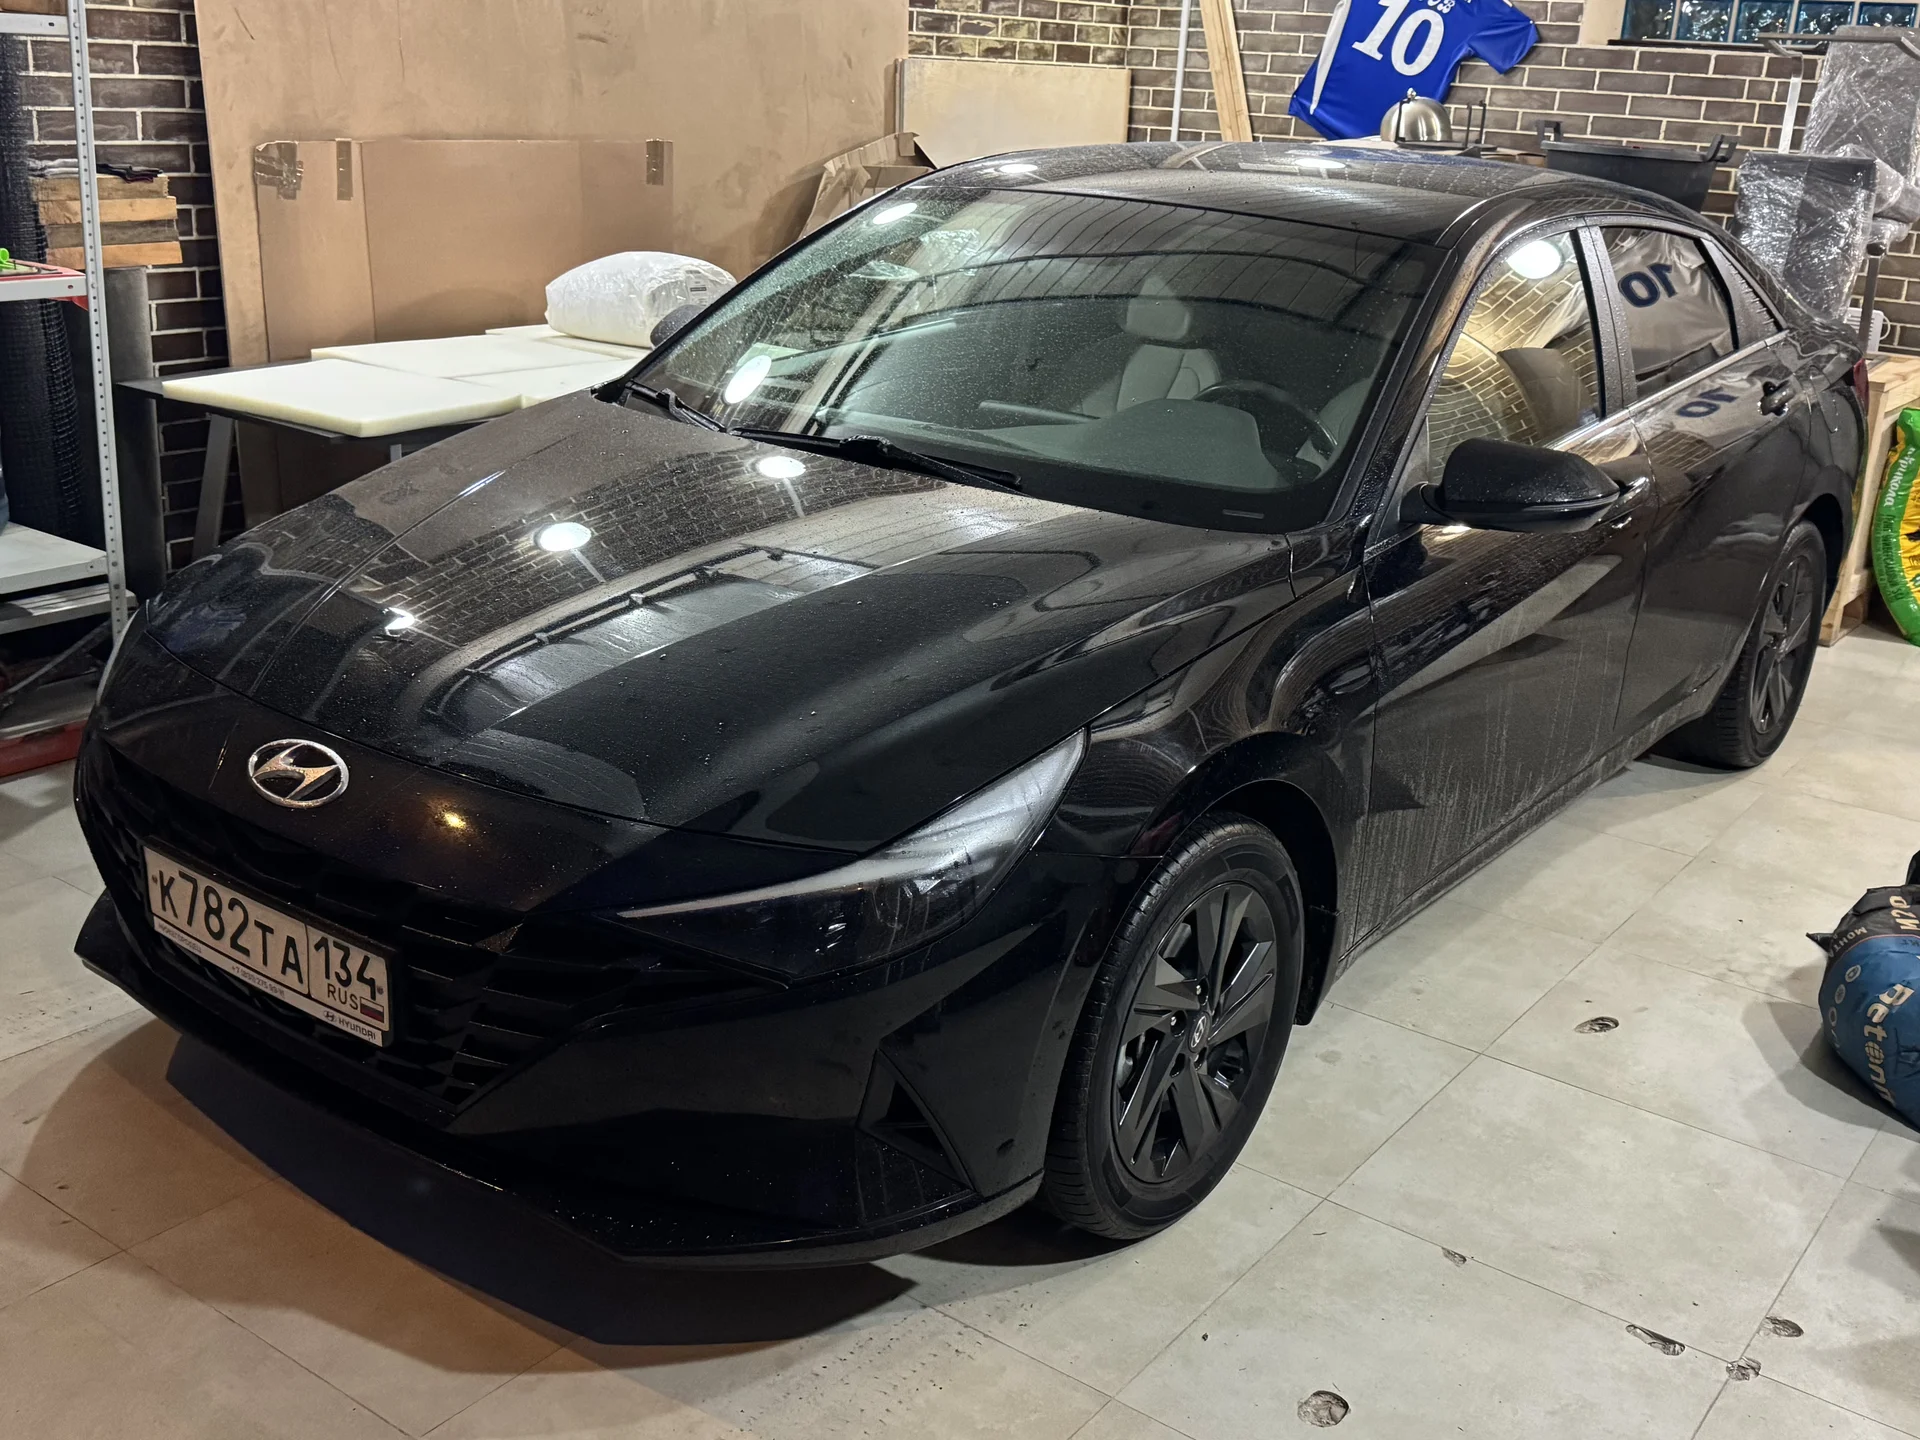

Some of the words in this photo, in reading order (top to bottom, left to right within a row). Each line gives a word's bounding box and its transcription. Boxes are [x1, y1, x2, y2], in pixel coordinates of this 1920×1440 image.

[1351, 0, 1444, 76] 10
[159, 869, 303, 984] К782ТА
[314, 936, 377, 1001] 134
[327, 983, 359, 1010] RUS
[338, 1017, 376, 1040] HYUNDAI
